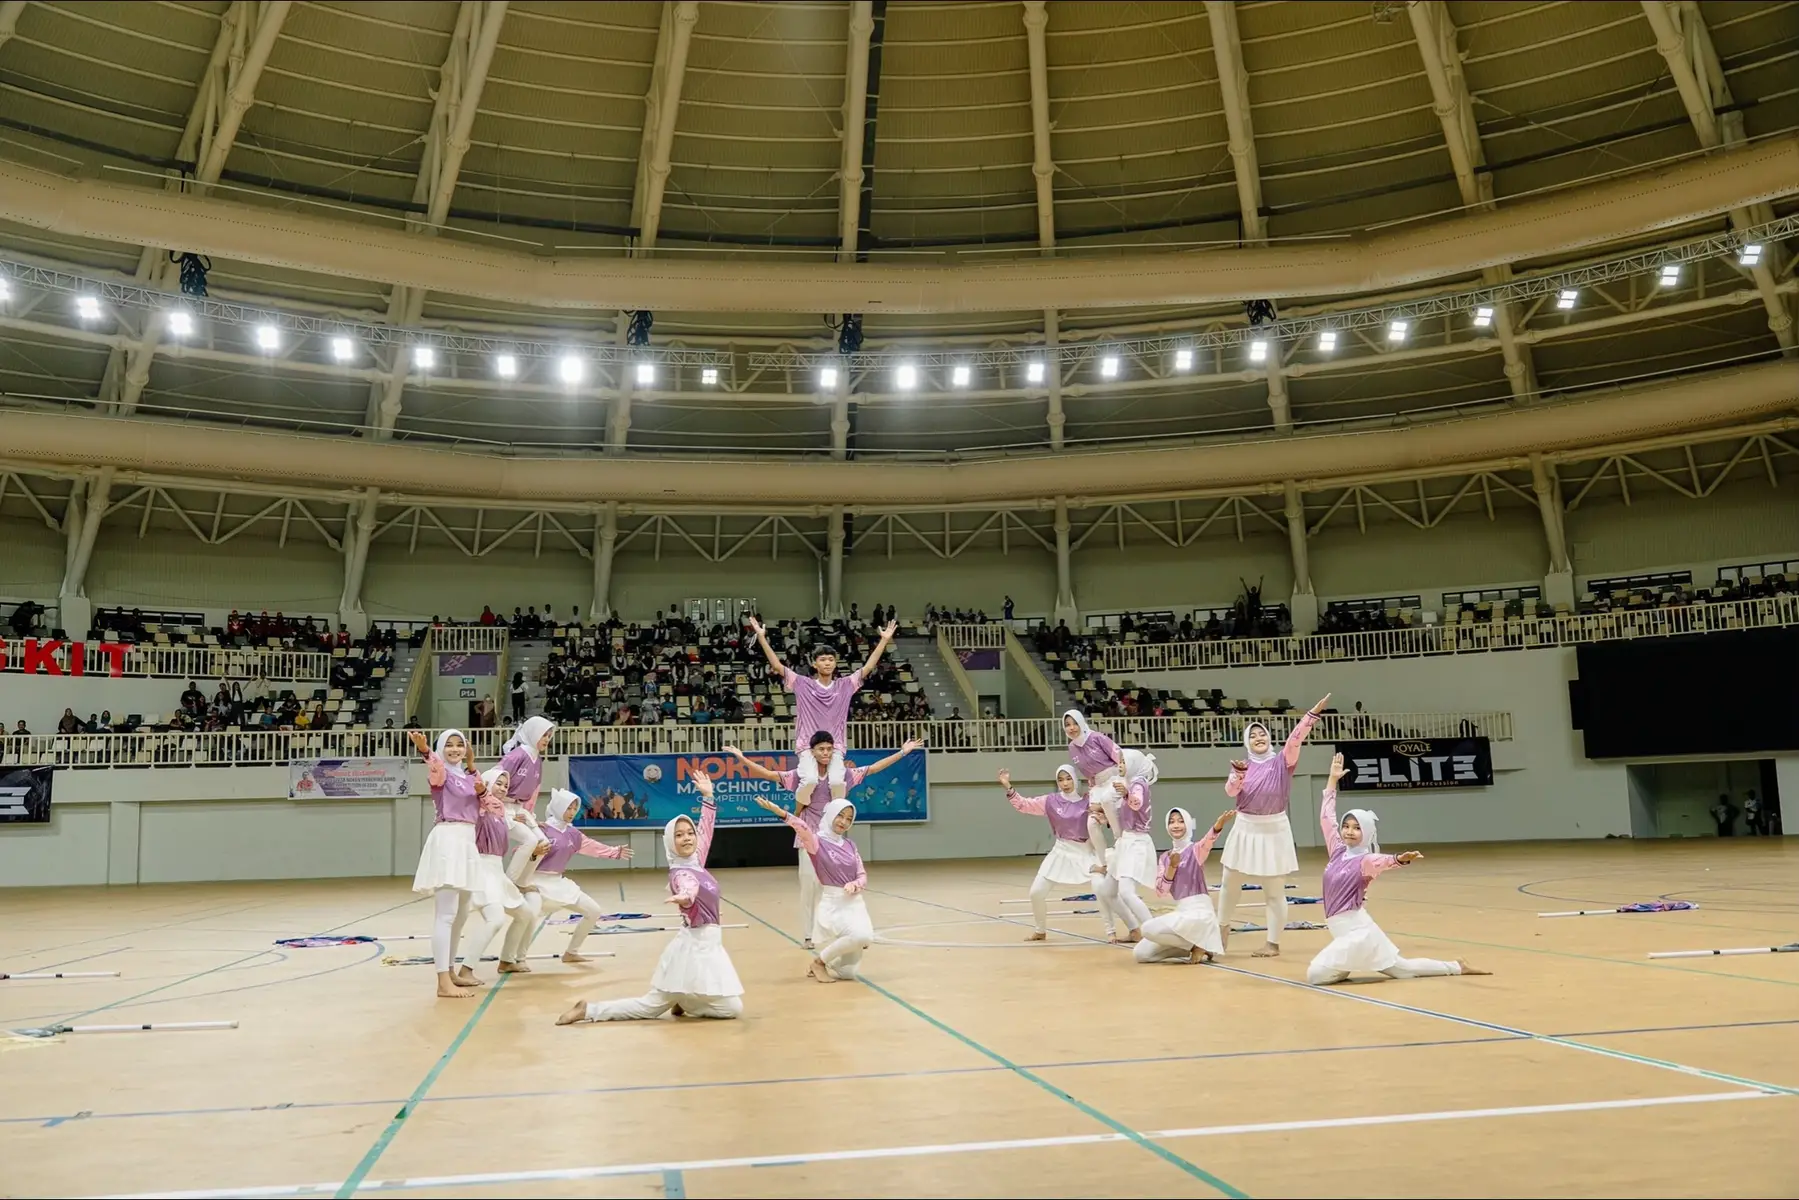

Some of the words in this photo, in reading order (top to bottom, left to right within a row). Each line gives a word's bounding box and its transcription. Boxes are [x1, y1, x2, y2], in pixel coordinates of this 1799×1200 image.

[0, 636, 134, 678] KIT
[1393, 743, 1432, 753] ROYALE
[1352, 755, 1478, 784] ELITE
[677, 781, 770, 794] MCHING
[696, 793, 768, 803] CMPETITION
[771, 793, 780, 801] III
